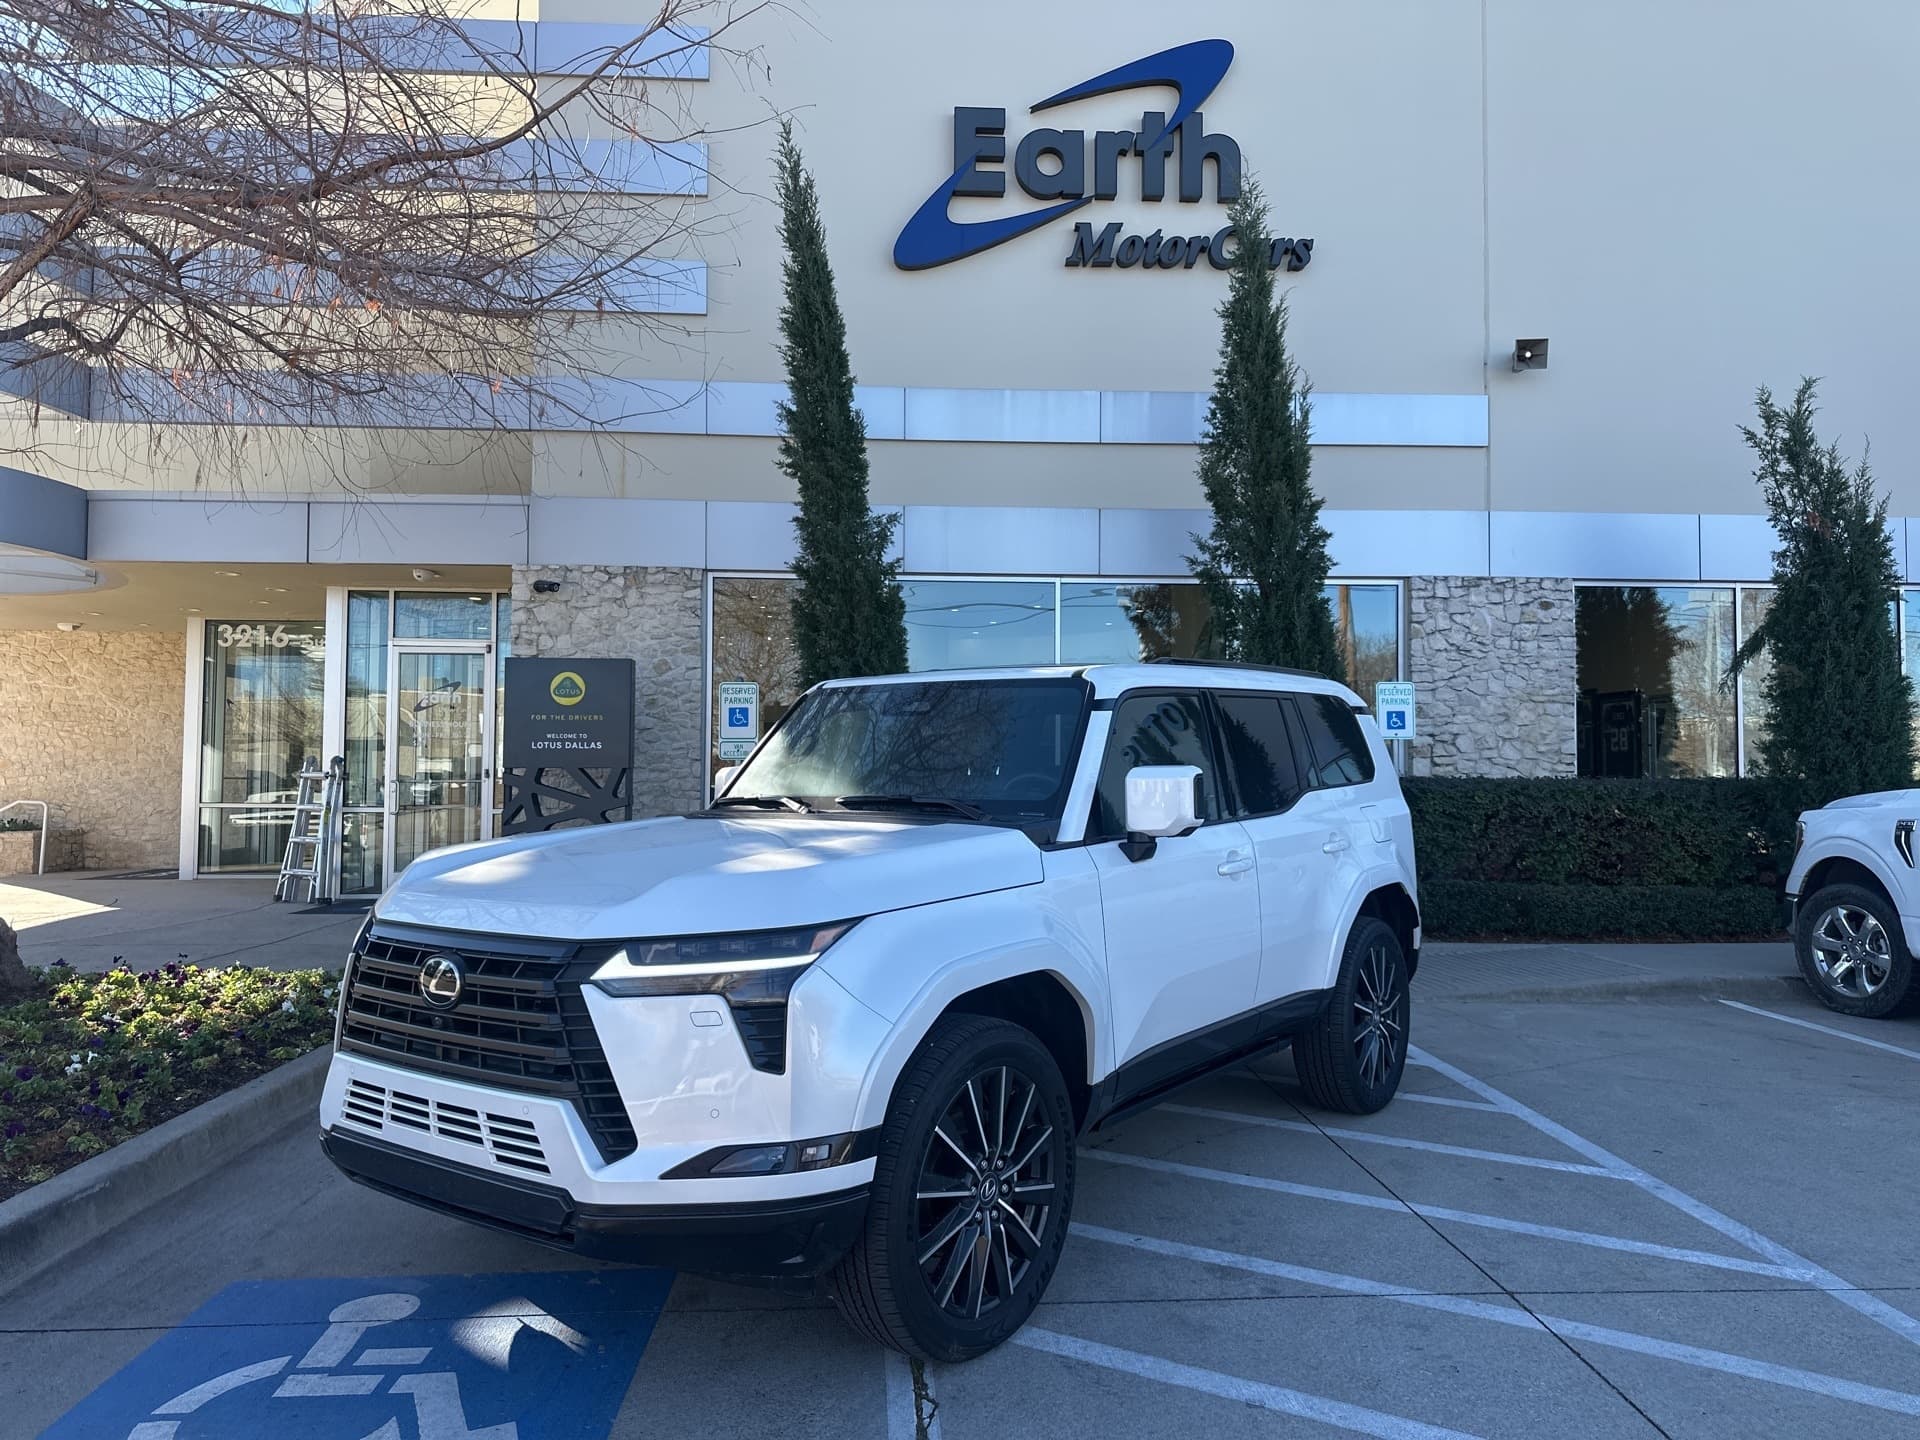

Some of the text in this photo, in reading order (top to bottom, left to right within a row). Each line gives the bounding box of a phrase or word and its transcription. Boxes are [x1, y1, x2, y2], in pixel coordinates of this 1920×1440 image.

[953, 105, 1242, 204] Earth
[1065, 221, 1315, 272] MotorCrs
[217, 624, 290, 649] 3216
[722, 687, 756, 695] RESERVED
[1379, 688, 1411, 696] RESERVED
[531, 741, 603, 749] LOTUS DALLAS
